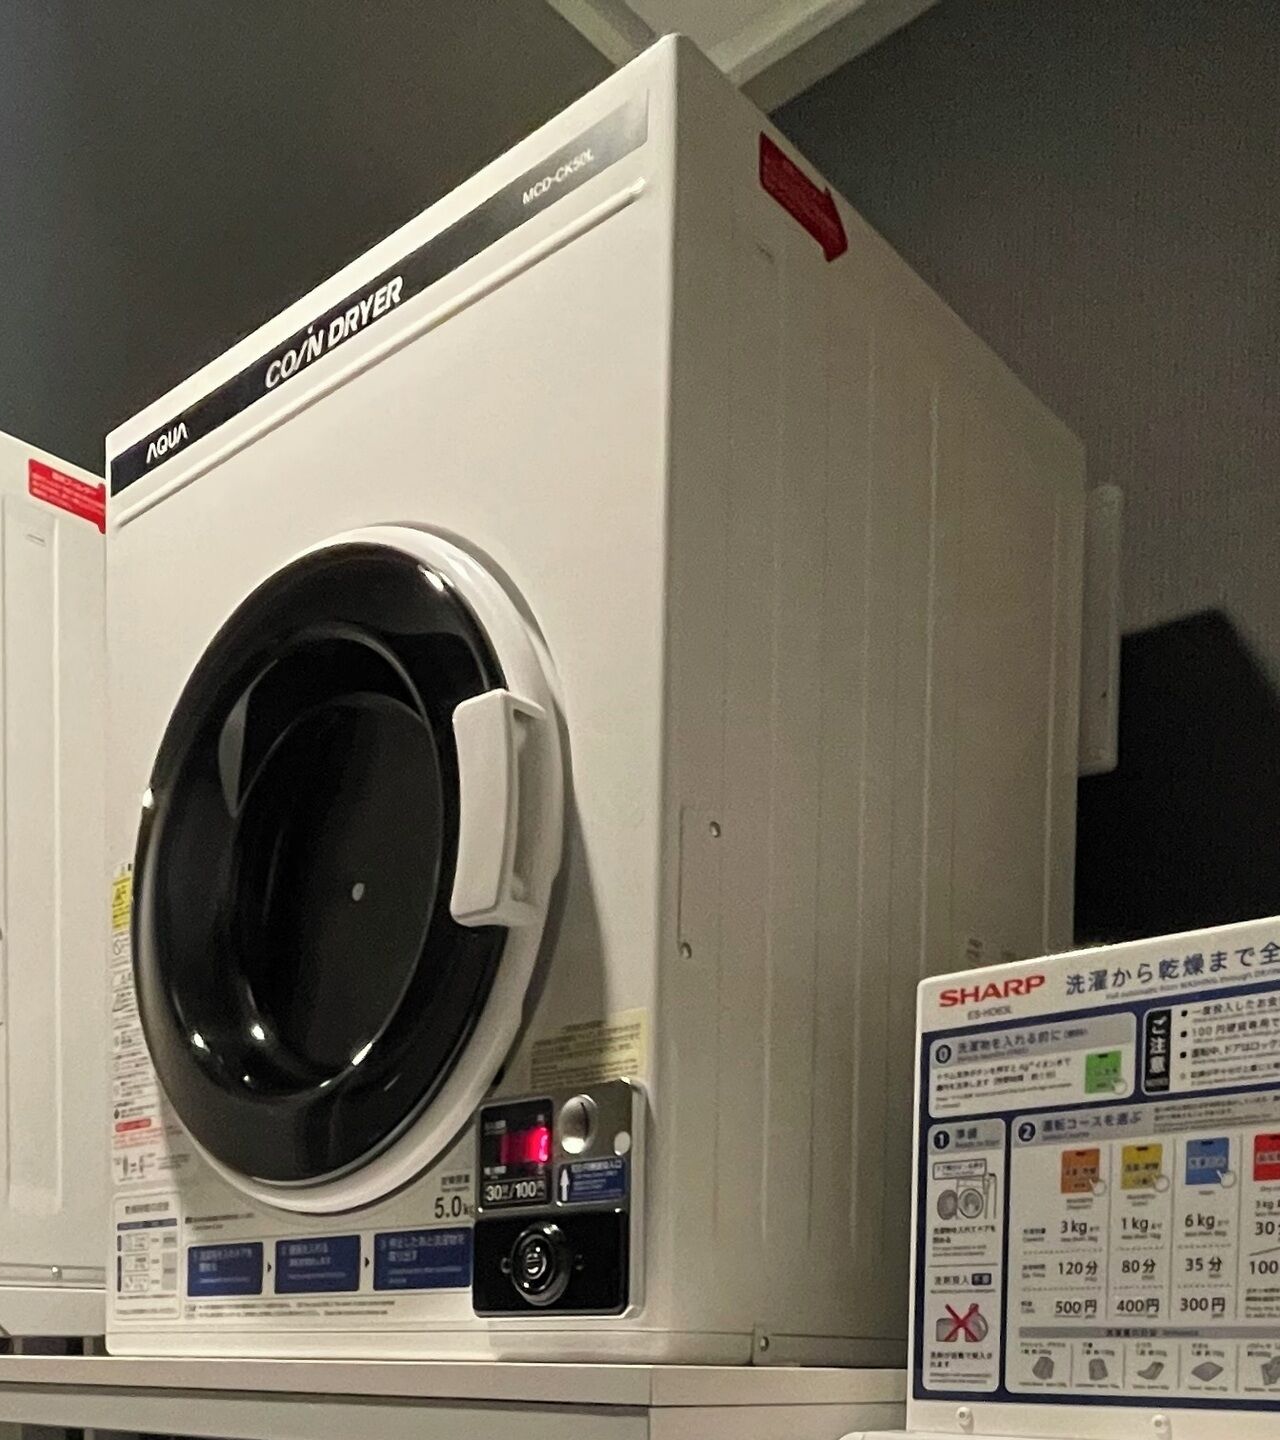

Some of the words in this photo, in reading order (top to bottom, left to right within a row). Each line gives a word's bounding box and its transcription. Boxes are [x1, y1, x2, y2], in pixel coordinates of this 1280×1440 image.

[327, 276, 403, 348] DRYER
[146, 422, 188, 463] AQUA
[939, 975, 1045, 1007] SHARP
